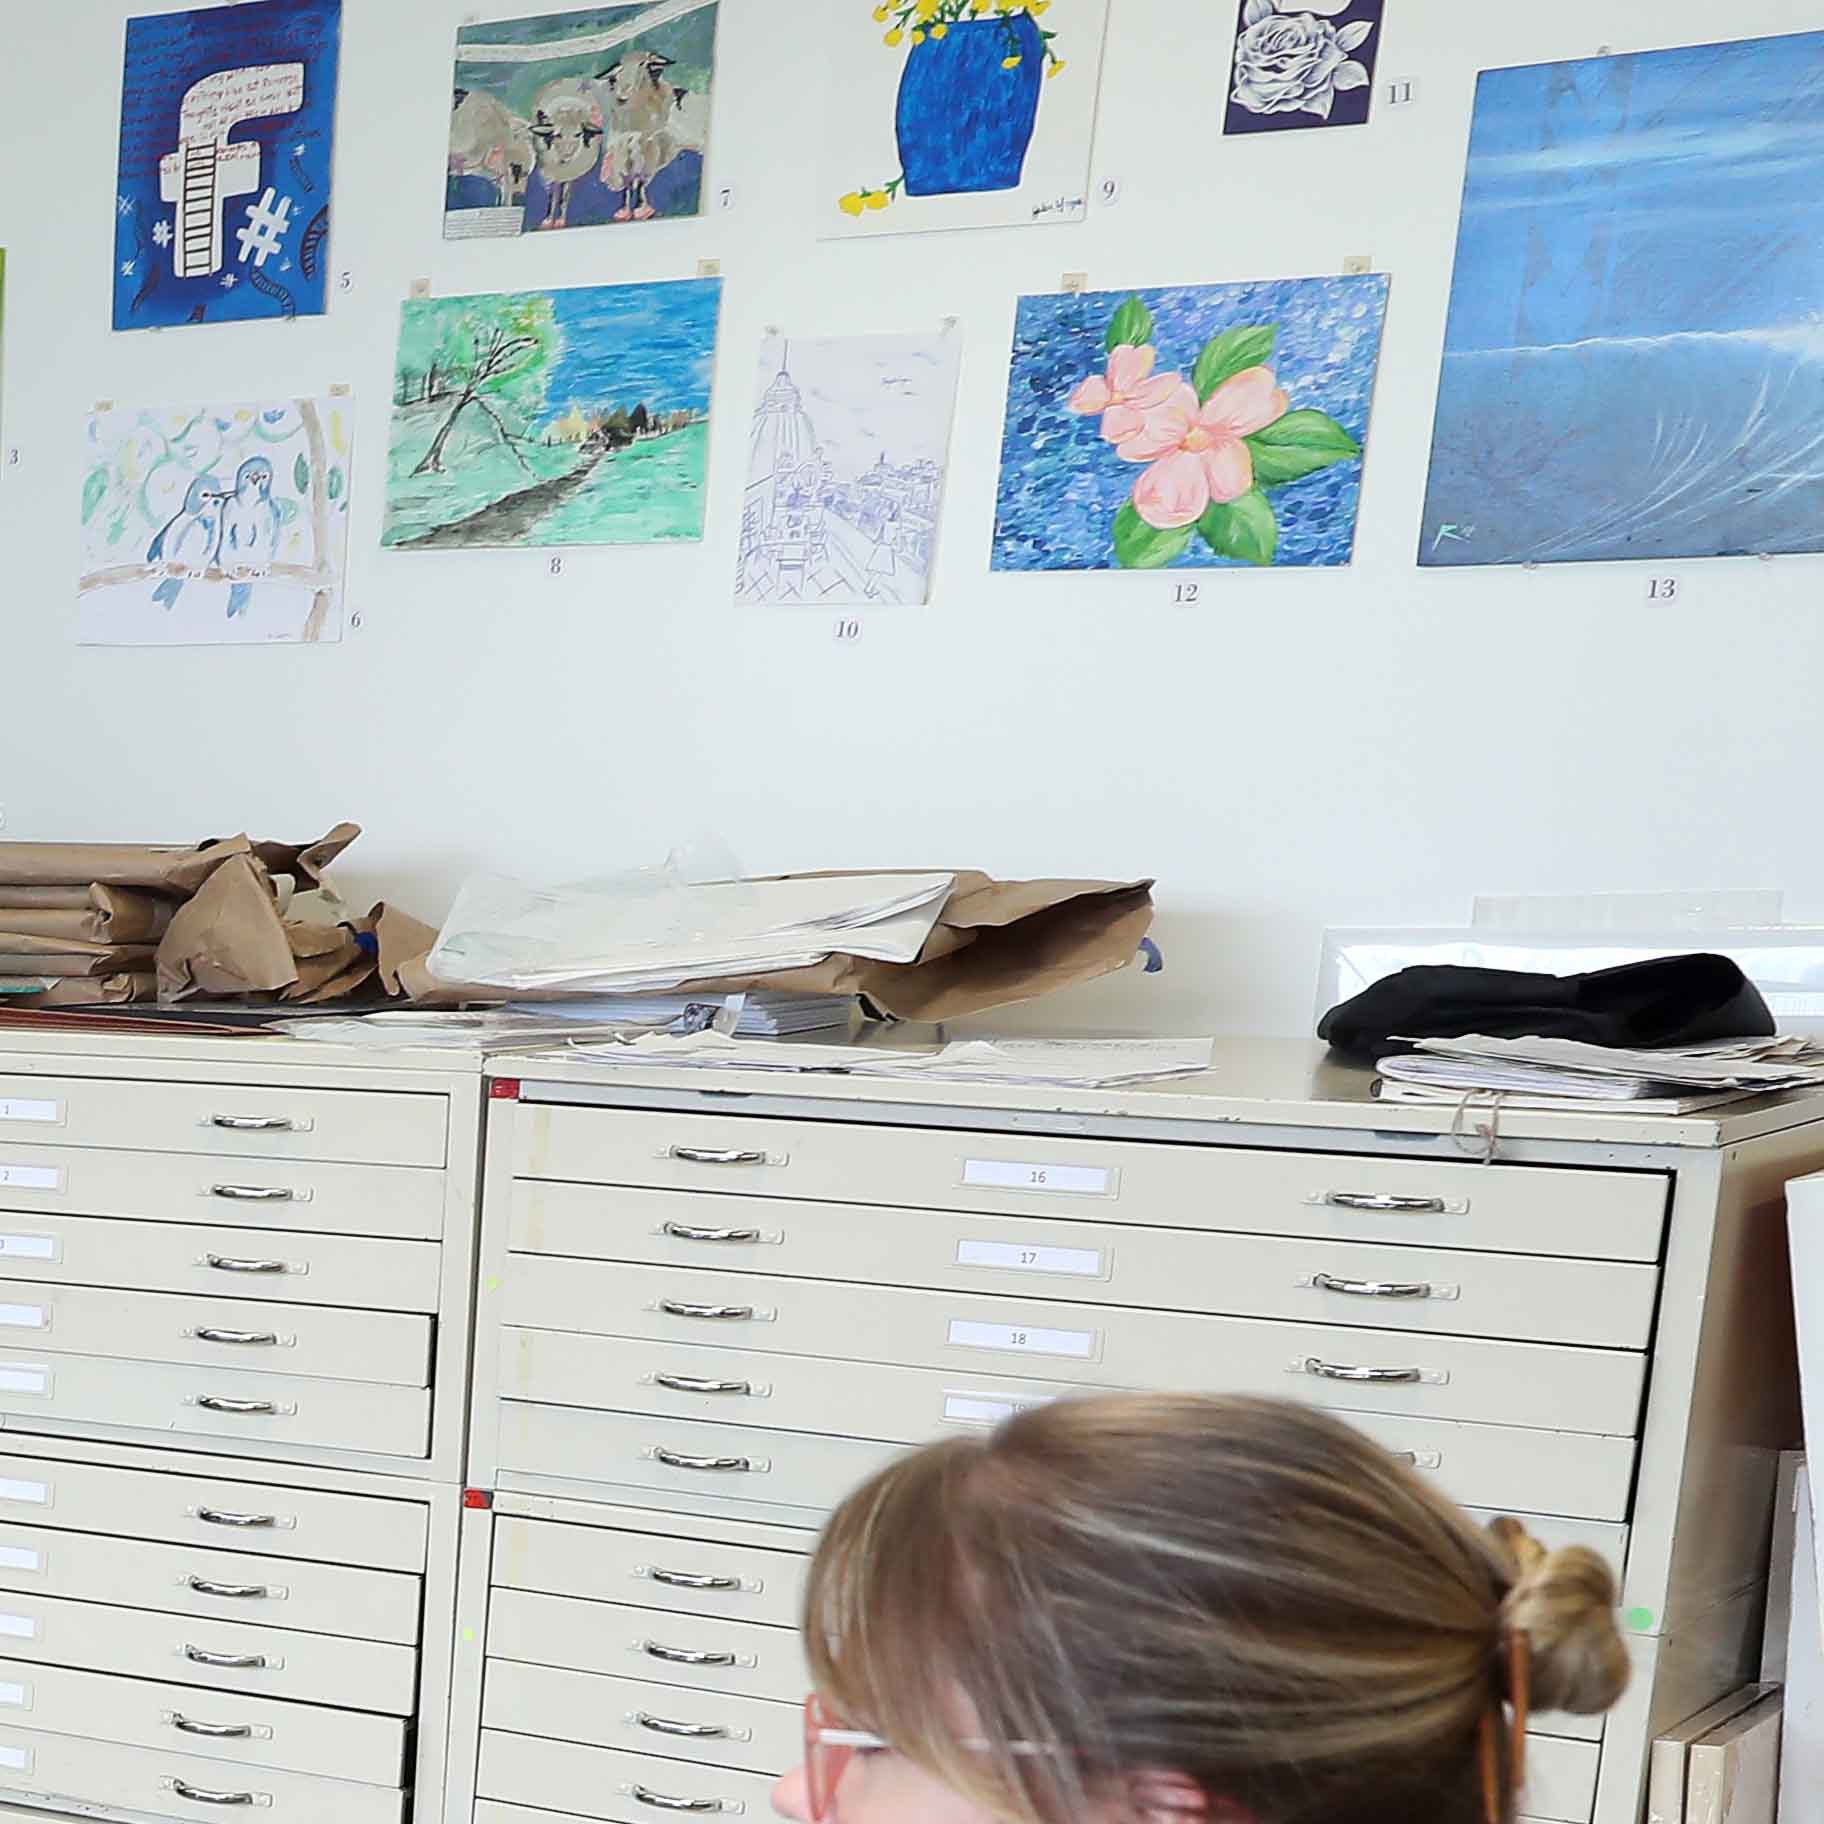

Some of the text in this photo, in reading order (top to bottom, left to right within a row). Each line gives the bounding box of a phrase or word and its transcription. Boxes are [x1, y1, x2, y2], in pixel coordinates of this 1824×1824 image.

[1391, 83, 1409, 104] 11
[722, 190, 729, 205] 7
[1104, 182, 1114, 199] 9
[343, 272, 349, 288] 5
[11, 450, 17, 464] 3
[551, 558, 560, 573] 8
[1176, 584, 1198, 601] 12
[1650, 579, 1675, 597] 13
[352, 613, 360, 626] 6
[839, 622, 858, 637] 10
[1031, 1172, 1046, 1183] 16
[1022, 1253, 1037, 1263] 17
[1011, 1333, 1026, 1344] 18
